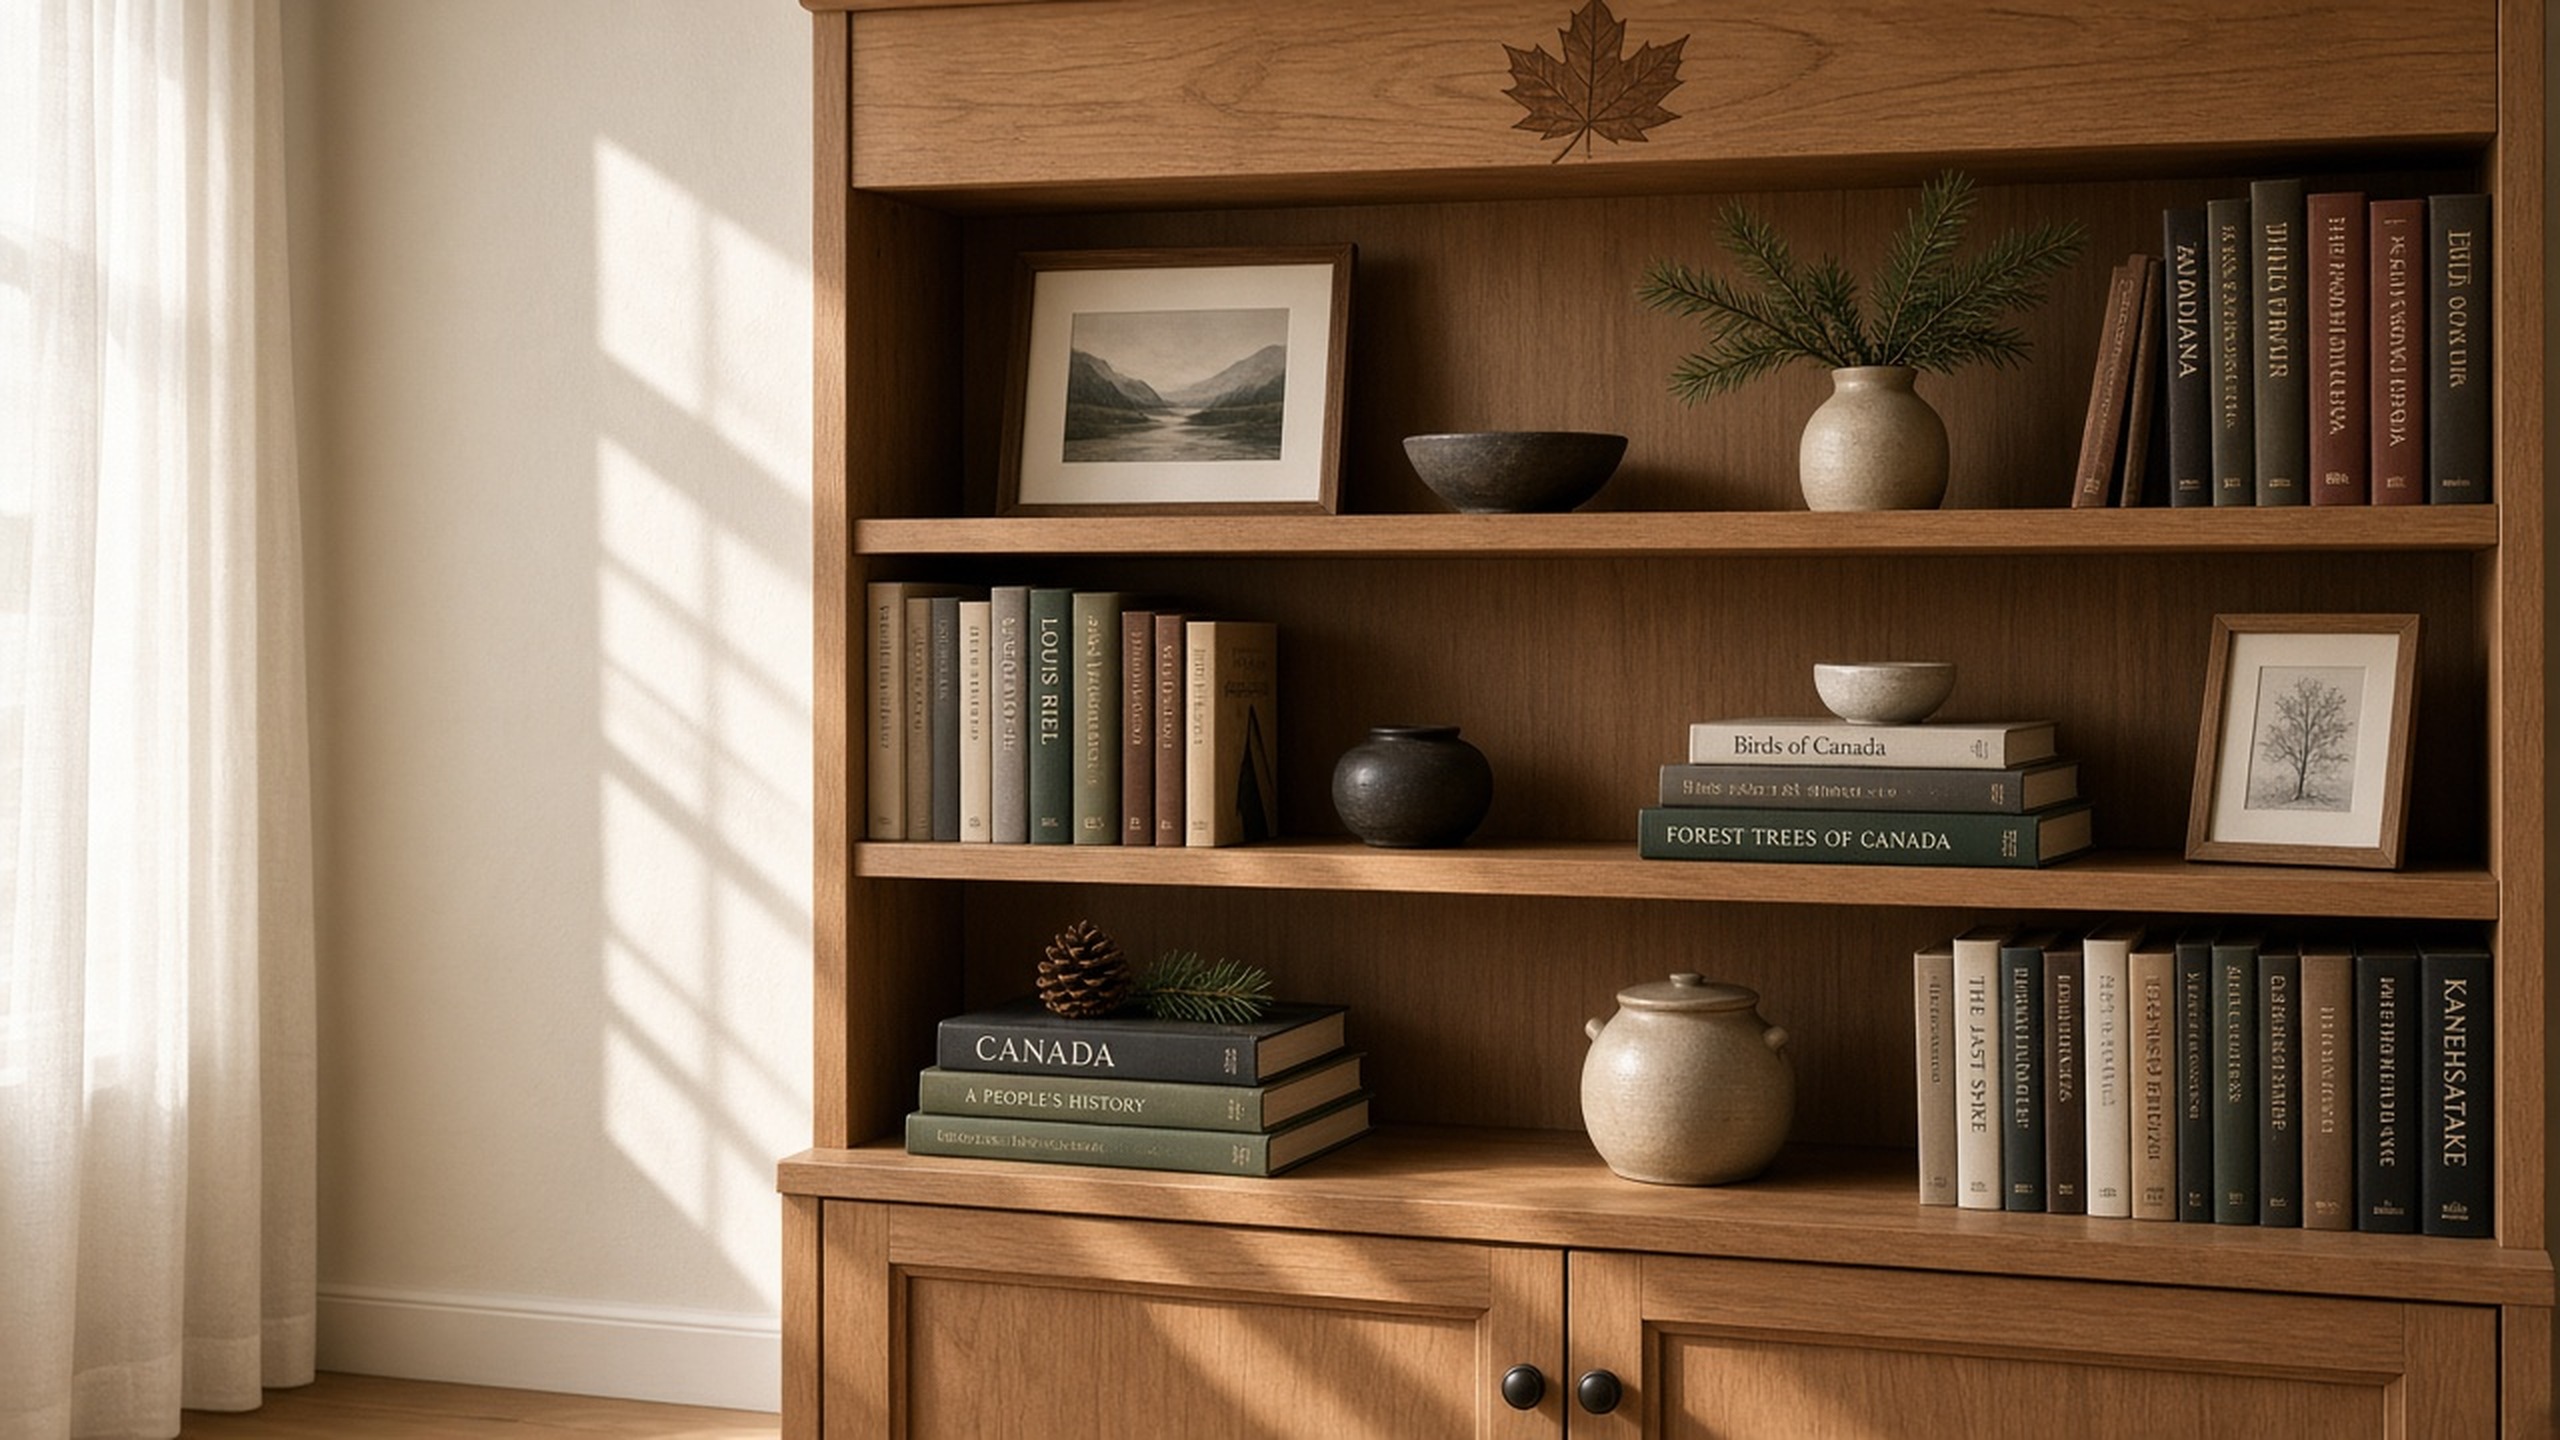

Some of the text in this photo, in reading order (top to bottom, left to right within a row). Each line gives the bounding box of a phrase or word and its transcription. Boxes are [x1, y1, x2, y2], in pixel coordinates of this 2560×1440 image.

[1041, 618, 1059, 746] LOUIS RIEL
[1734, 735, 1887, 757] Birds of Canada
[1667, 826, 1951, 850] FOREST TREES OF CANADA
[1969, 975, 1986, 1015] THE
[975, 1035, 1115, 1068] CANADA
[2443, 979, 2467, 1167] KANEHSATAKE
[965, 1087, 1146, 1114] A PEOPLE'S HISTORY
